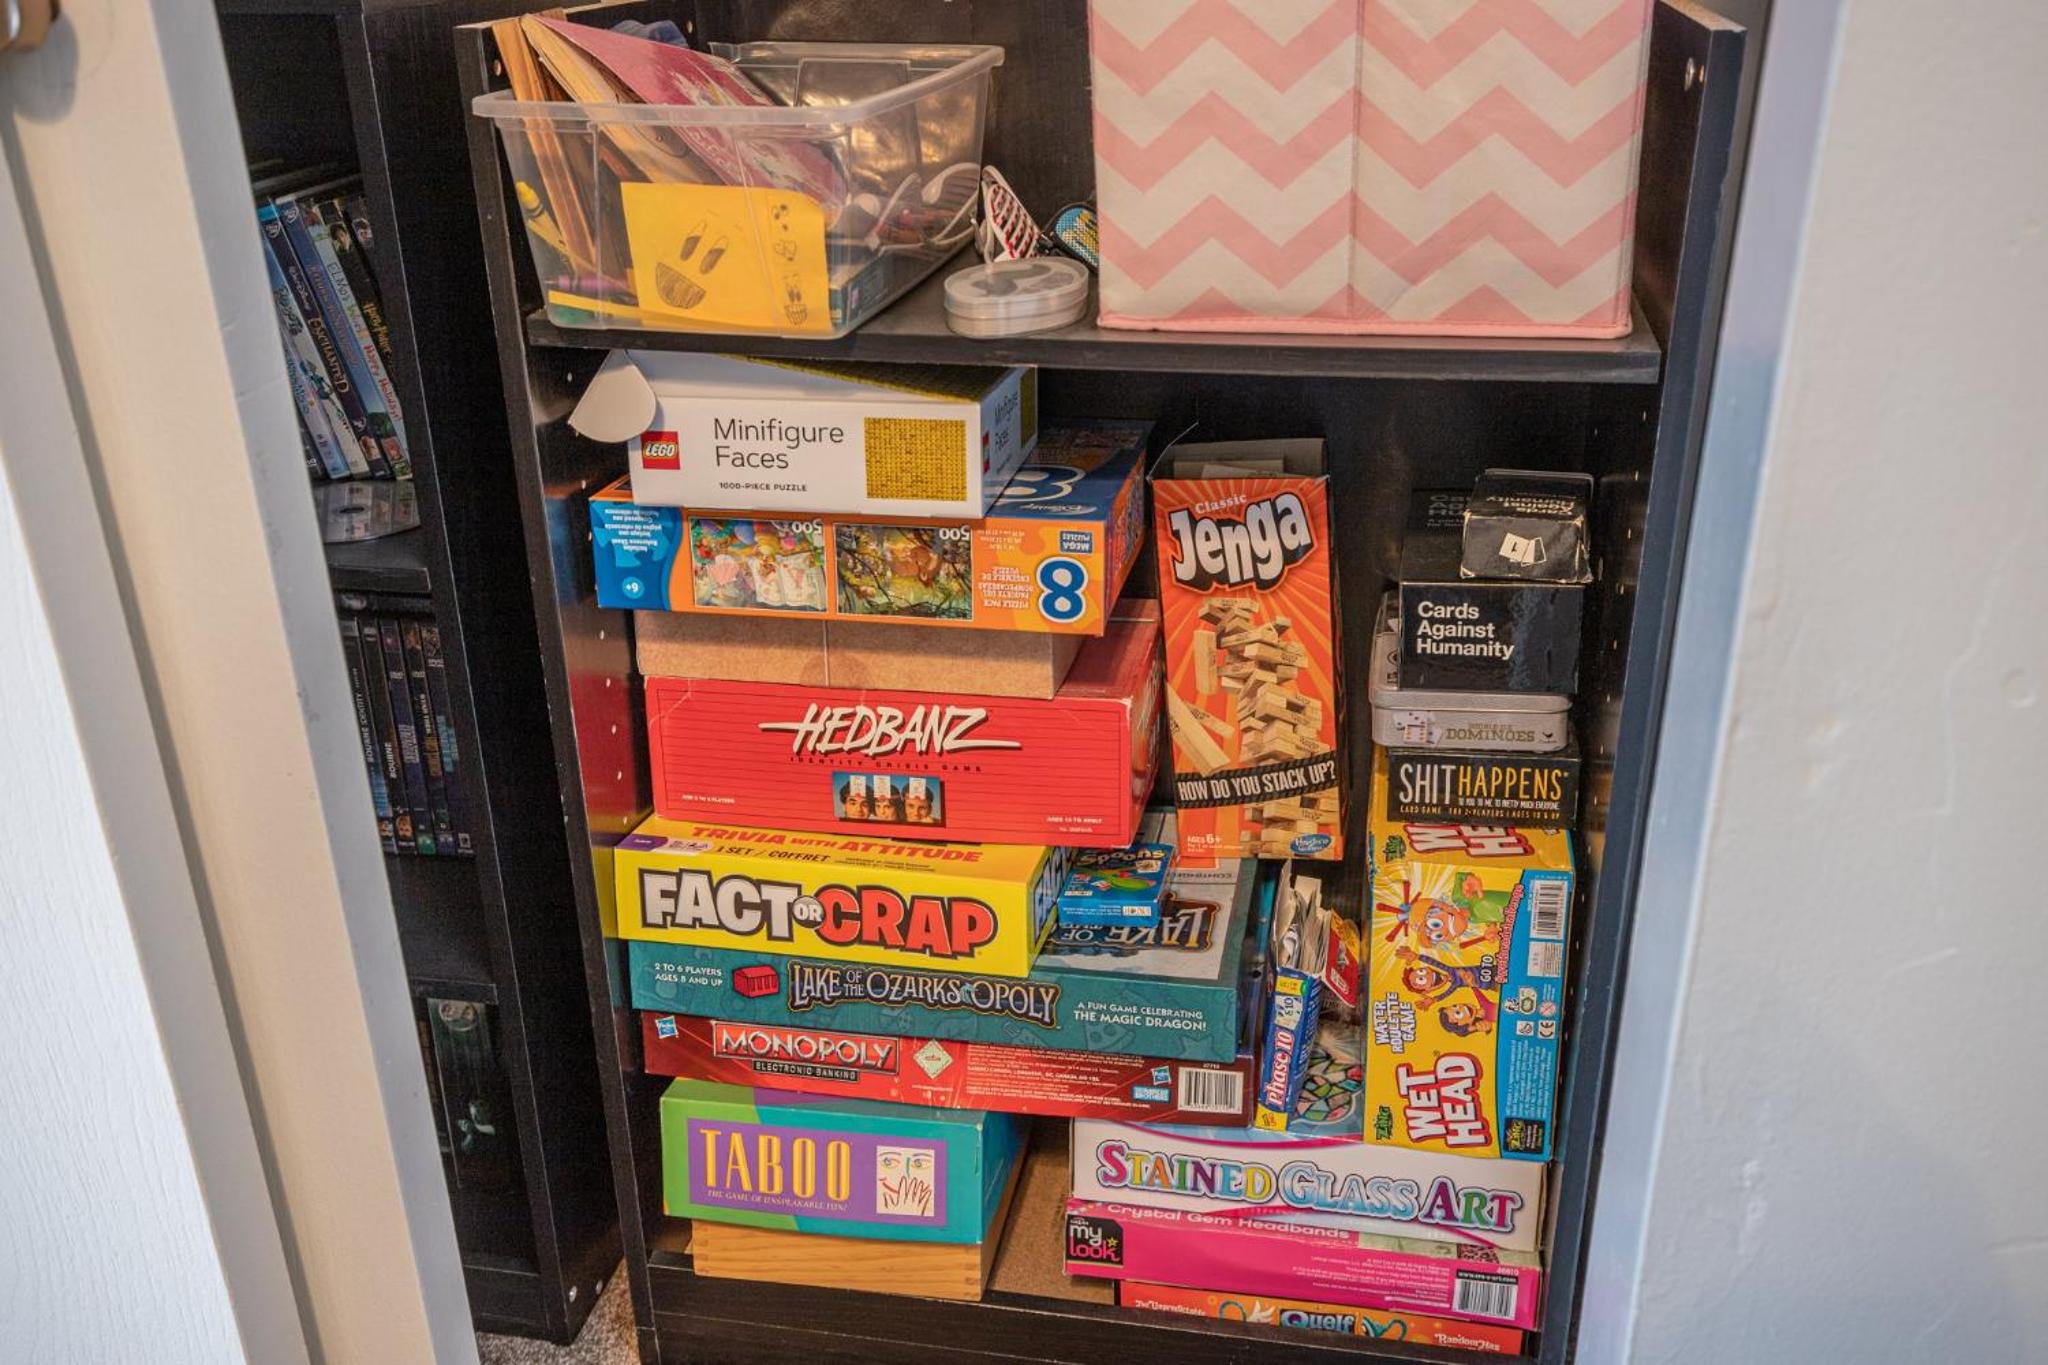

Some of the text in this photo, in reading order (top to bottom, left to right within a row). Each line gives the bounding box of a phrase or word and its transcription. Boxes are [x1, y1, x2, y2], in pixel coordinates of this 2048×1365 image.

[714, 418, 844, 449] Minifigure
[645, 443, 676, 458] LEGO
[715, 446, 789, 469] Faces
[719, 482, 807, 492] 1000-PIECE PUZZLE
[1195, 494, 1247, 514] Classic
[792, 519, 822, 535] 500
[939, 525, 970, 541] 500
[1062, 541, 1090, 551] MEGA
[1170, 493, 1312, 584] Jenga
[626, 582, 639, 592] 6+
[1036, 557, 1088, 622] 8
[1417, 601, 1480, 619] Cards
[1416, 620, 1496, 640] Against
[1416, 638, 1515, 660] Humanity
[758, 703, 1022, 756] HEDBANZ
[1446, 728, 1536, 743] DOMINOES
[790, 757, 981, 772] IDENTITY CRISIS GAME
[1178, 760, 1337, 801] HOW DO YOU STACK UP?
[1399, 763, 1562, 804] SHIT HAPPENS
[1400, 805, 1418, 813] CARD
[1422, 806, 1441, 814] GAME
[692, 826, 786, 845] TRIVIA
[791, 837, 838, 848] WITH
[838, 841, 983, 863] ATTITUDE
[1187, 833, 1221, 844] AGES 6+
[723, 846, 755, 856] SET
[768, 850, 831, 862] COFFRET
[641, 869, 801, 941] FACT
[797, 902, 823, 923] OR
[817, 887, 994, 955] CRAP
[1061, 930, 1095, 942] OF
[655, 963, 722, 977] 2 TO 6 PLAYERS
[655, 973, 723, 987] AGES 8 AND UP
[846, 971, 862, 983] OF
[1480, 956, 1494, 983] GO TO
[794, 965, 842, 1006] LAKE
[844, 983, 865, 998] THE
[1078, 1001, 1203, 1019] A FUN GAME CELEBRATING
[1073, 1010, 1207, 1032] THE MAGIC DRAGON!
[1374, 1001, 1389, 1045] WATER
[1387, 992, 1405, 1053] ROULETTE
[1401, 1002, 1416, 1041] GAME
[721, 1029, 894, 1069] MONOPOLY
[1274, 1030, 1295, 1051] 10
[755, 1062, 857, 1080] ELECTRONIC BANKING
[1264, 1049, 1292, 1106] Phase
[1397, 1066, 1448, 1140] WET
[1436, 1055, 1487, 1145] HEAD
[700, 1128, 851, 1202] TABOO
[1100, 1143, 1519, 1230] STAINED GLASS ART
[707, 1190, 848, 1211] THE GAME OF UNSPEAKABLE FUN!
[1108, 1203, 1351, 1239] Crystal Gem Headbands
[1070, 1225, 1102, 1247] my
[1070, 1237, 1120, 1262] look
[1135, 1299, 1151, 1309] The
[1280, 1310, 1355, 1331] Quelf
